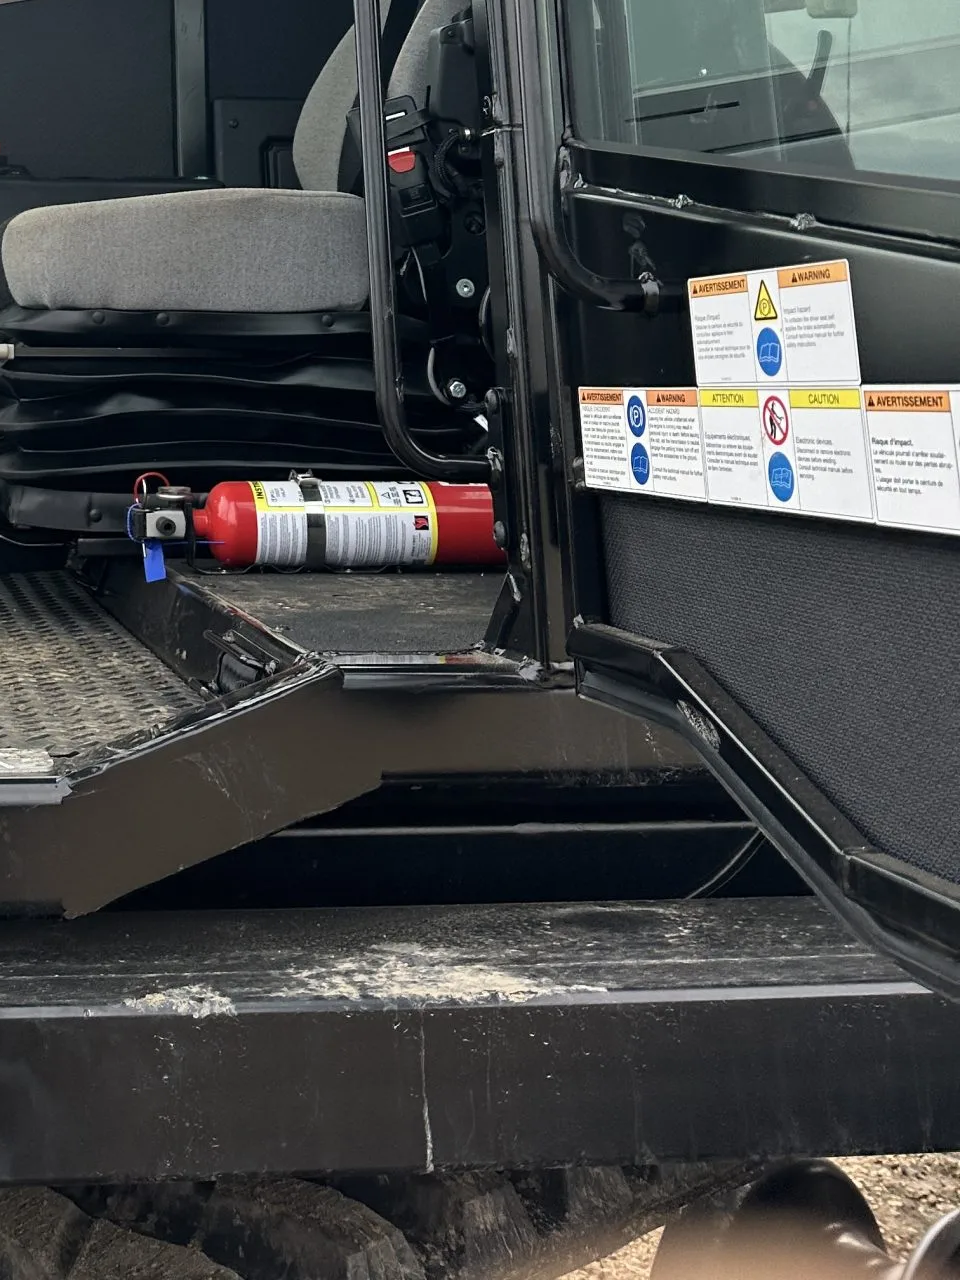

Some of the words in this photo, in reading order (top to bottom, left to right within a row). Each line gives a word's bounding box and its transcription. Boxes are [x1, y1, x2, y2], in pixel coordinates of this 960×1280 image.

[797, 269, 831, 282] WARNING
[698, 279, 745, 293] AVERTISSEMENT
[586, 393, 622, 401] AVERTISSEMENT
[661, 394, 686, 403] WARNING
[712, 393, 744, 403] ATTENTION
[808, 394, 840, 404] CAUTION
[876, 396, 944, 408] AVERTISSEMENT
